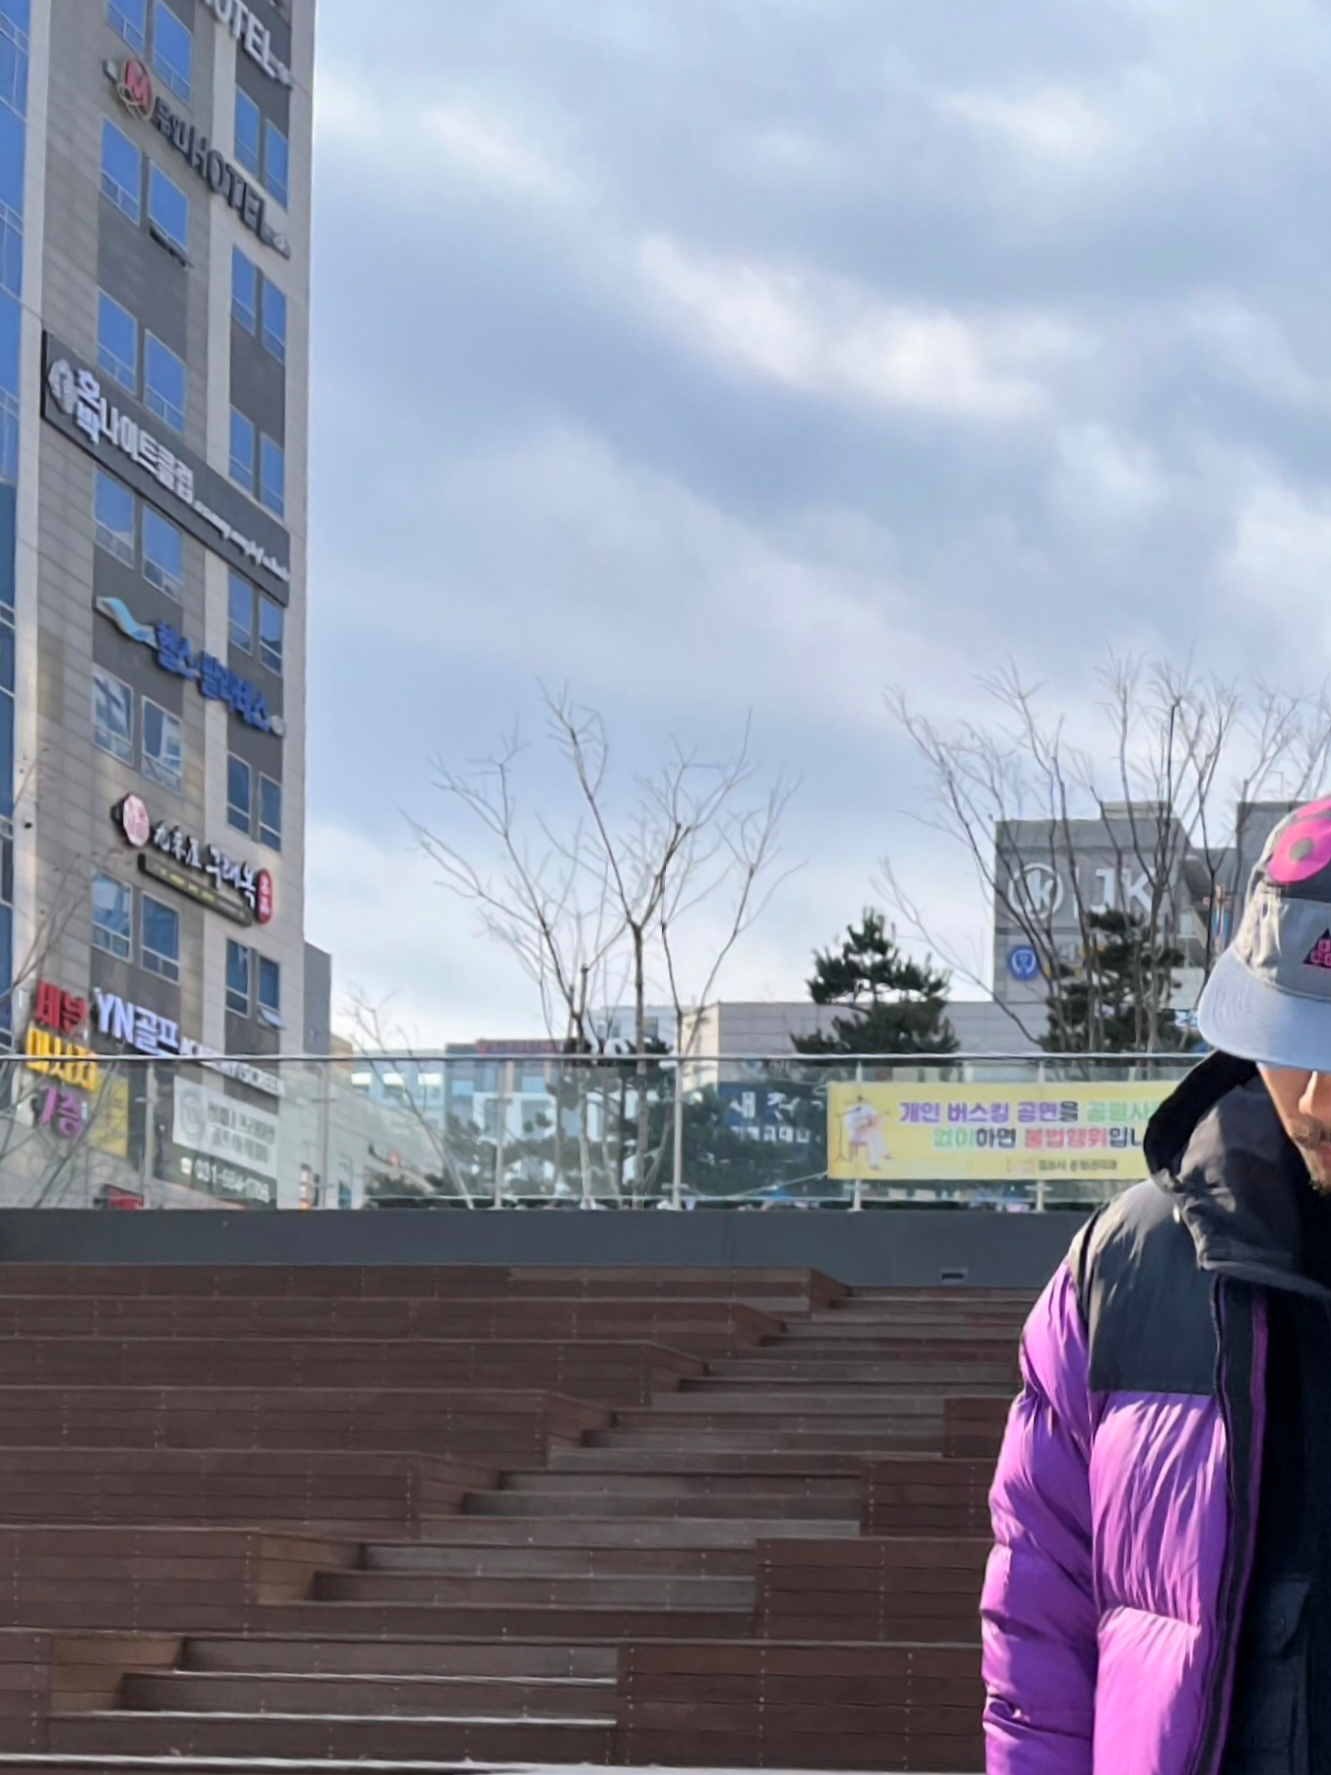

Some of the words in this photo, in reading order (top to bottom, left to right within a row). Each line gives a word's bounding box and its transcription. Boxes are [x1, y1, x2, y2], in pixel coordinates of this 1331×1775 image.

[204, 0, 277, 79] OTEL
[899, 1101, 941, 1123] 개인
[947, 1101, 1009, 1124] 버스킹
[1017, 1101, 1079, 1123] 공연을
